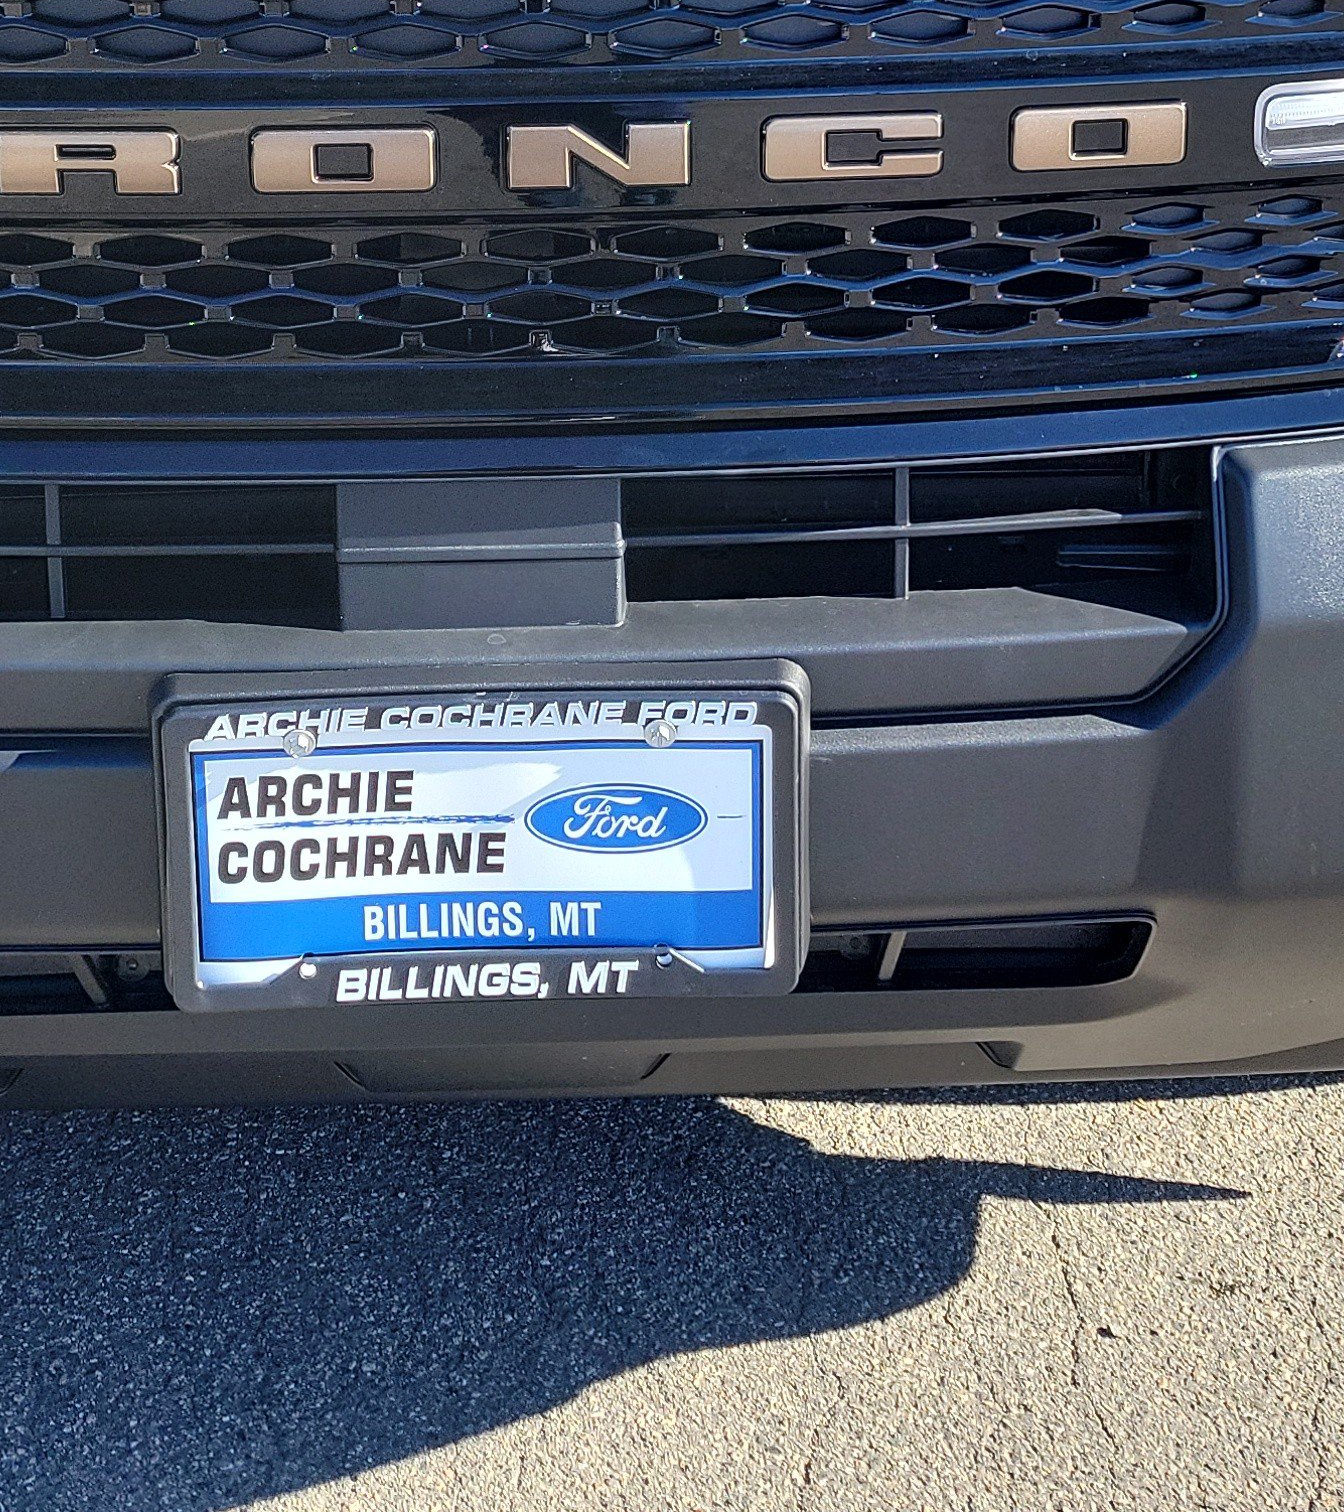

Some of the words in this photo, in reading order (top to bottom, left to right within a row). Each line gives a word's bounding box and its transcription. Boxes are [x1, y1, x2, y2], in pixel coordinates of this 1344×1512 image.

[204, 707, 368, 741] ARCHIE
[381, 700, 626, 730] COCHRANE
[637, 700, 758, 727] FORD
[217, 770, 415, 821] ARCHIE
[563, 794, 666, 839] Ford
[217, 832, 506, 885] COCHRANE
[363, 901, 537, 942] BILLINGS,
[550, 901, 602, 937] MT
[335, 966, 550, 1004] BILLINGS,
[567, 960, 639, 994] MT
